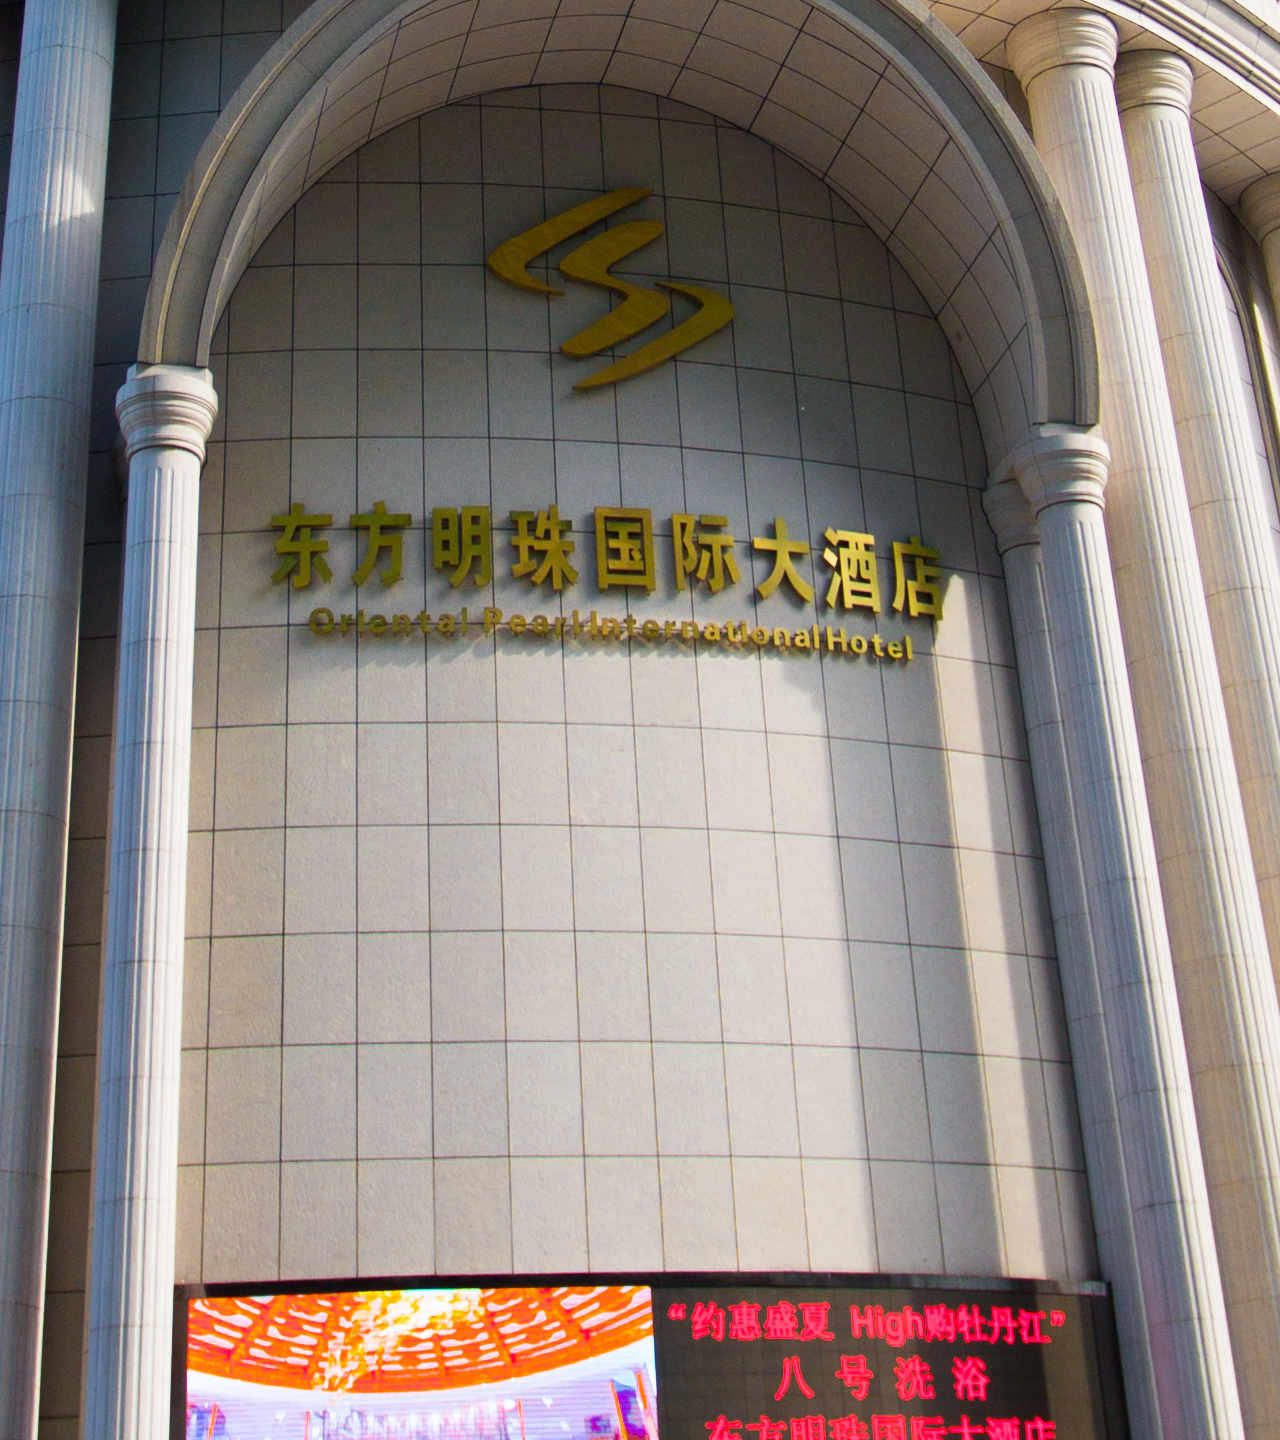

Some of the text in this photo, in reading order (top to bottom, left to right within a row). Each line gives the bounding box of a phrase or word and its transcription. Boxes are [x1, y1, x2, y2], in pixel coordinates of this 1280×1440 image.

[270, 502, 945, 622] 东方明珠国际大酒店
[308, 606, 915, 662] Oriental Pearl International Hotel
